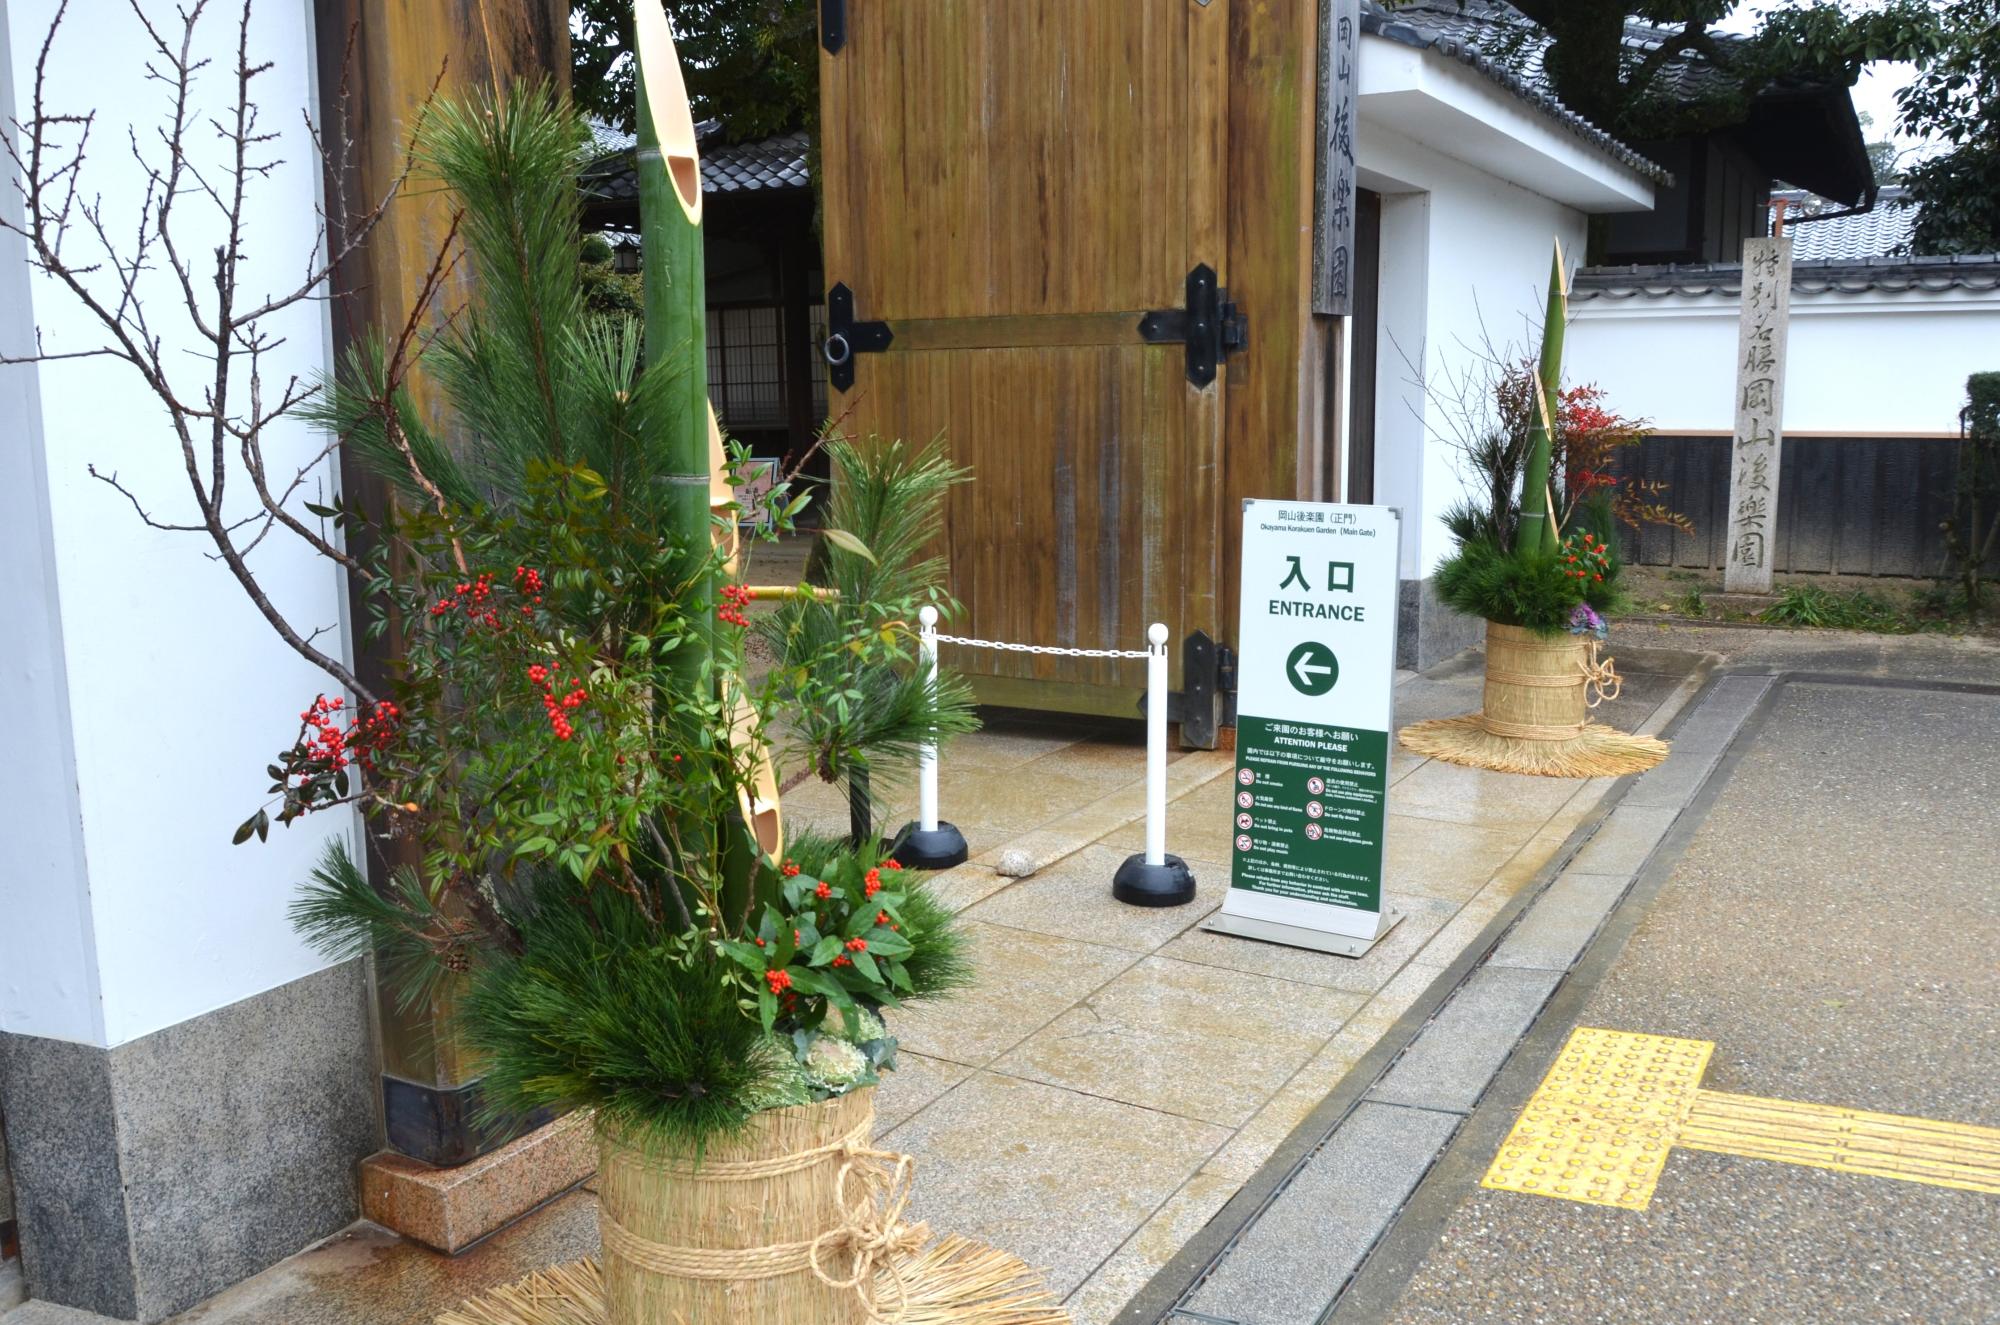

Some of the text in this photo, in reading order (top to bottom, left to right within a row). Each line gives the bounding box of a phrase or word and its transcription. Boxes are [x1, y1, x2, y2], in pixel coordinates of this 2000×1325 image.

[1330, 16, 1354, 299] 岡山後楽園
[1260, 523, 1287, 532] Okayama
[1287, 525, 1315, 533] Korakuen
[1315, 526, 1337, 534] Garden
[1279, 555, 1354, 593] 入口
[1269, 600, 1365, 622] ENTRANCE
[1265, 723, 1359, 742] ご来園のお客様へお願い
[1274, 736, 1348, 752] ATTENTION PLEASE
